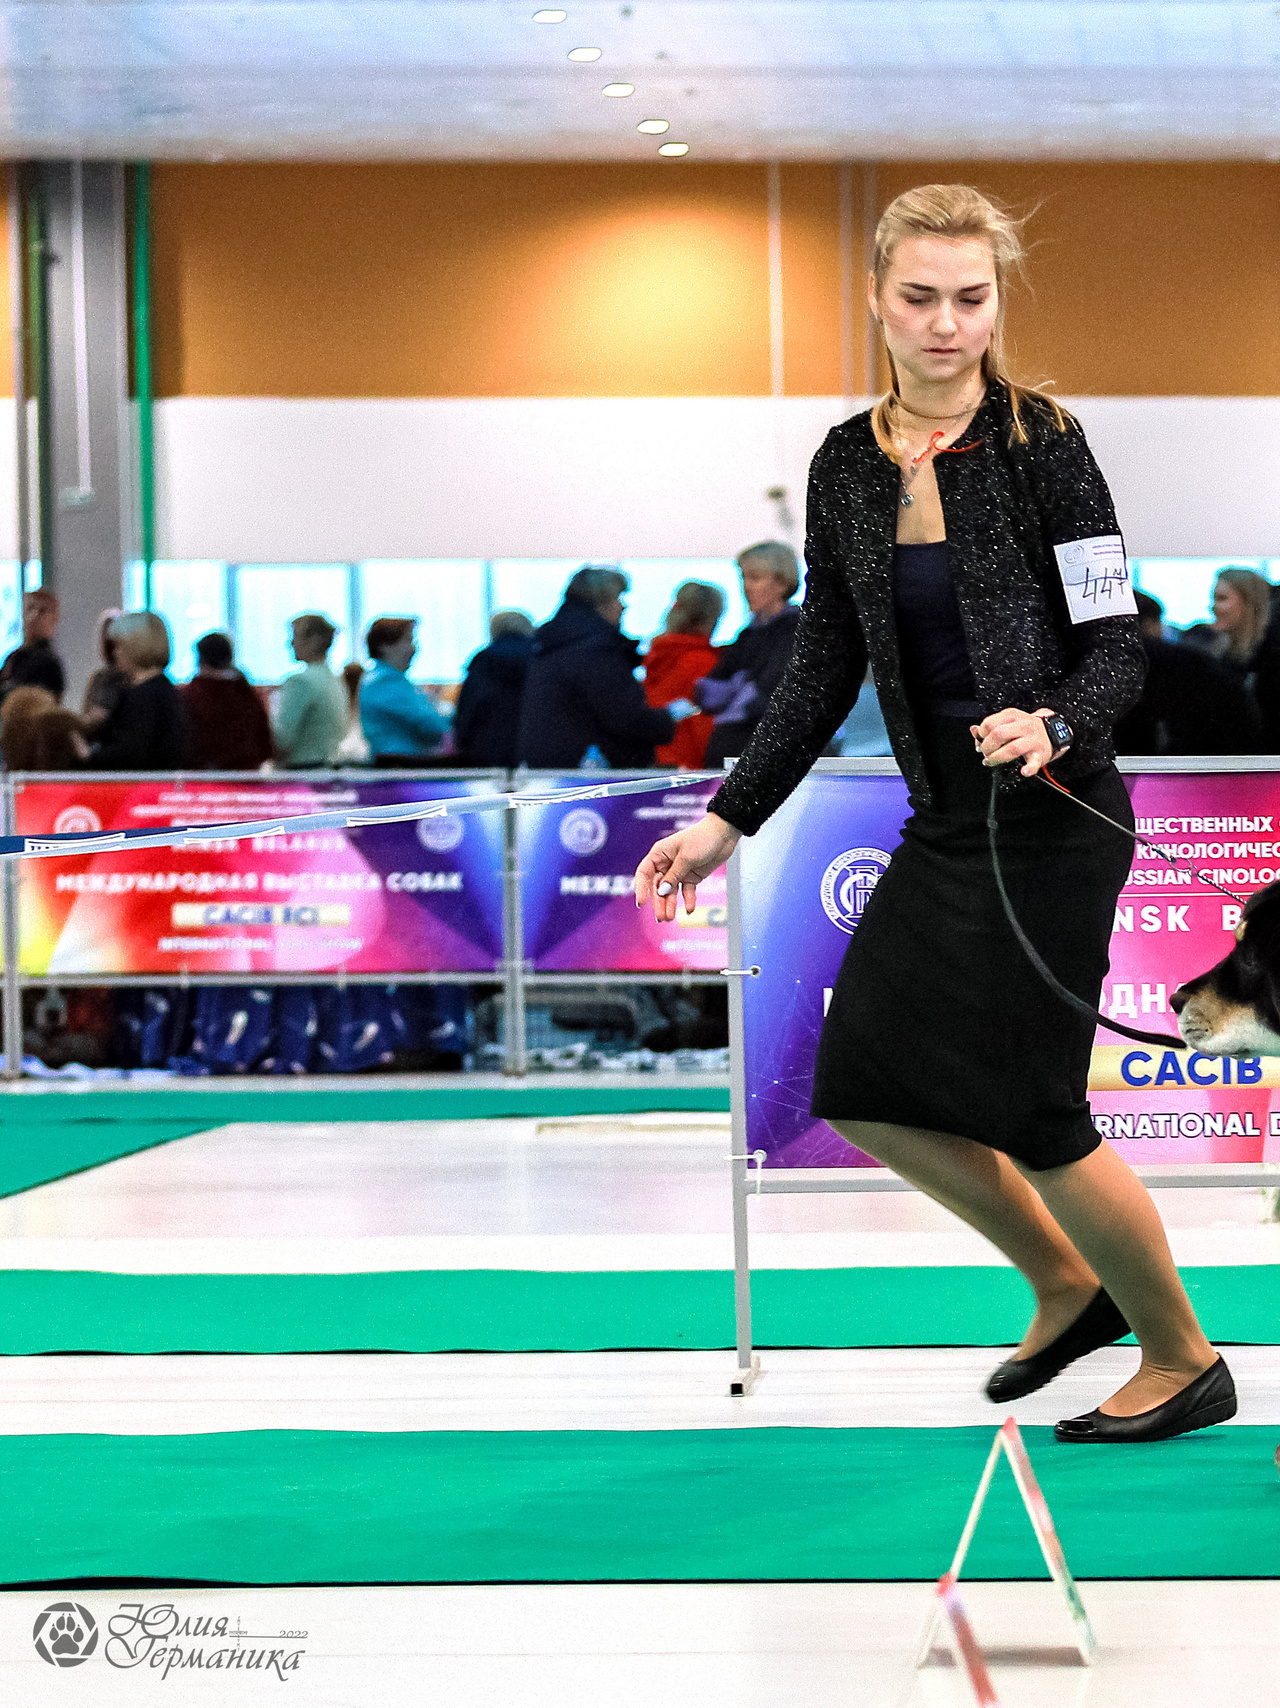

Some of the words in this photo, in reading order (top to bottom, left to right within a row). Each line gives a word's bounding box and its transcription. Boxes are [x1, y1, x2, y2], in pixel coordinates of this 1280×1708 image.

[1135, 816, 1274, 835] ЩЕСТВЕННЫХ
[1113, 904, 1191, 932] NSK
[1121, 1051, 1263, 1086] CACIB
[1090, 1112, 1261, 1138] RNATIONAL
